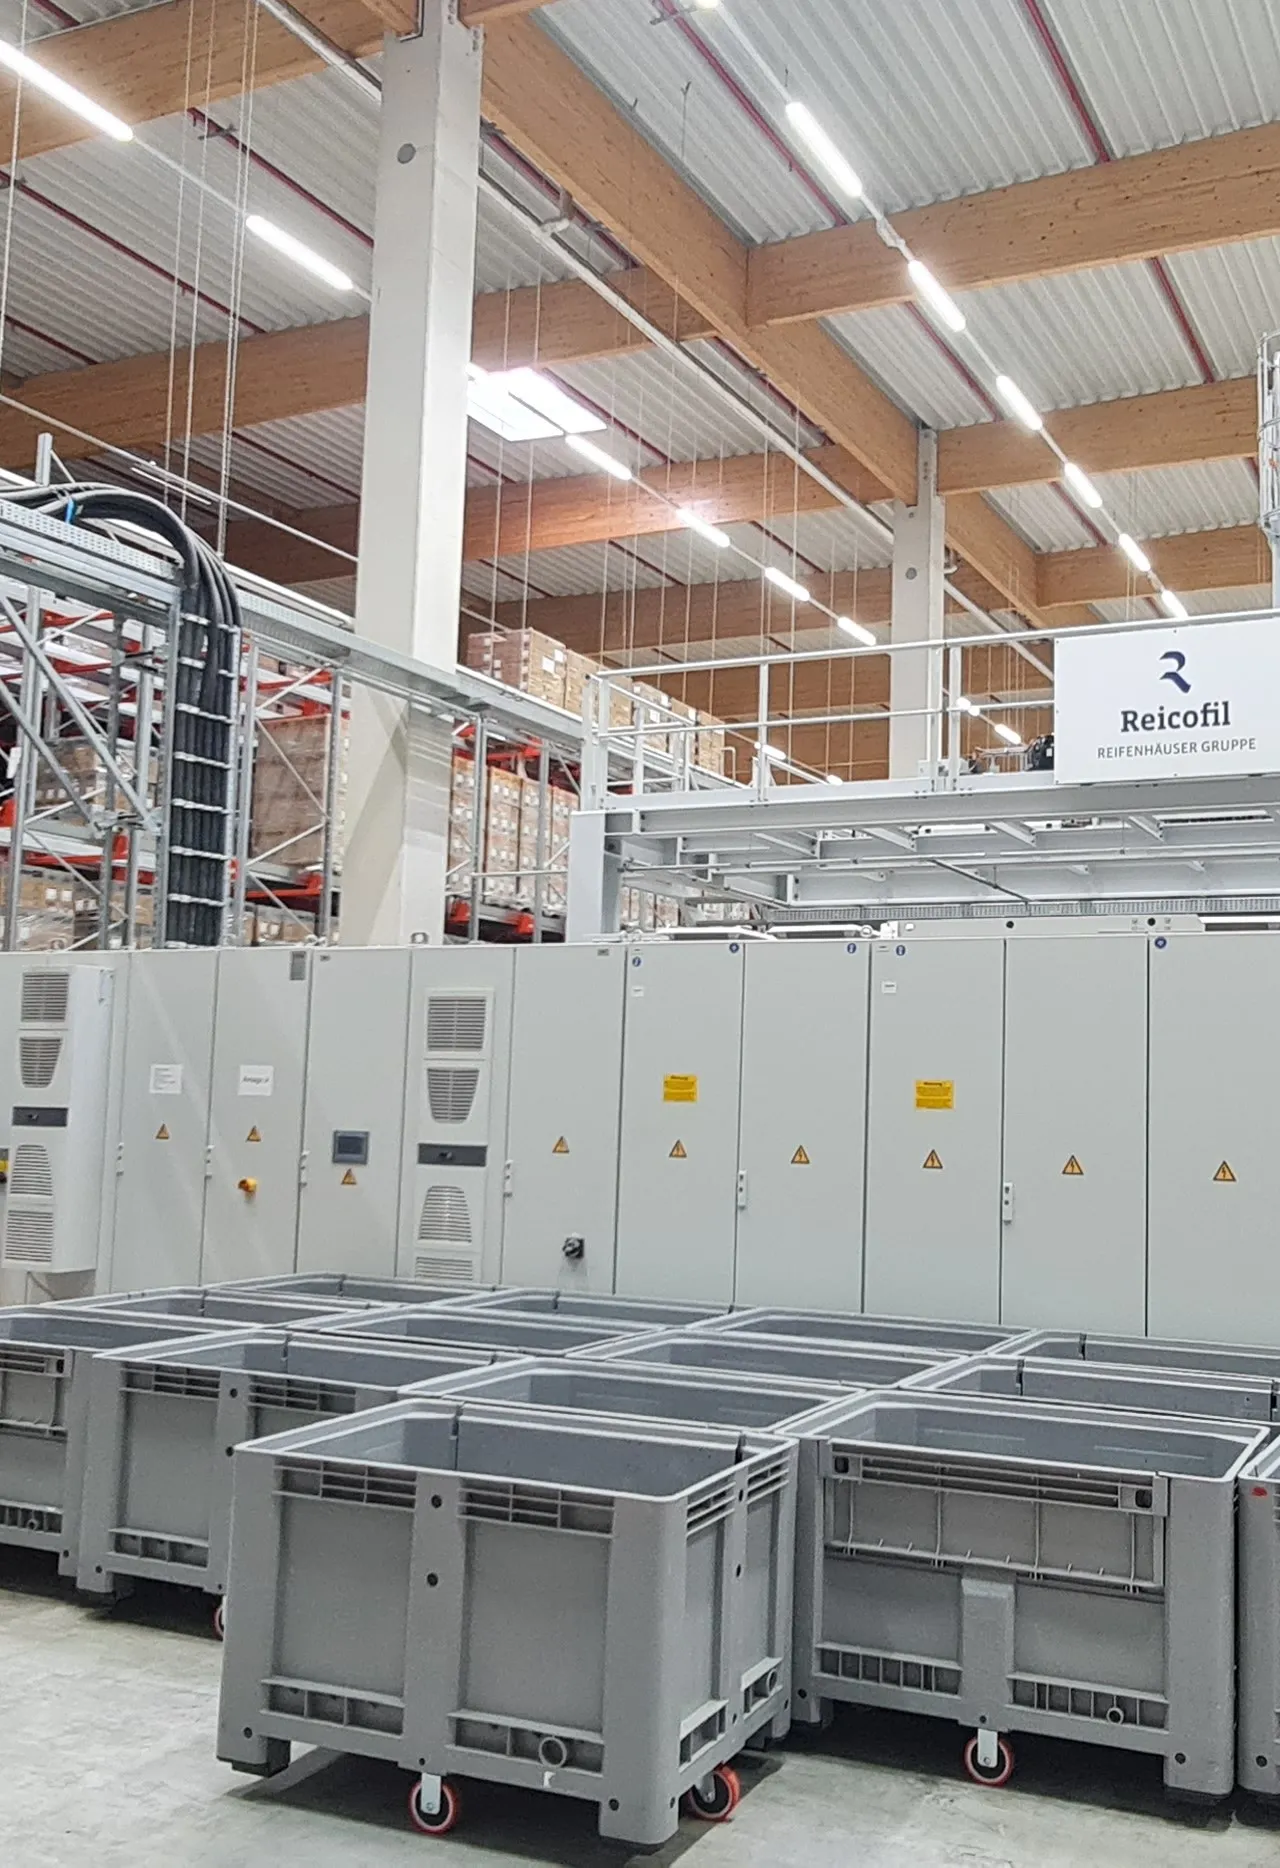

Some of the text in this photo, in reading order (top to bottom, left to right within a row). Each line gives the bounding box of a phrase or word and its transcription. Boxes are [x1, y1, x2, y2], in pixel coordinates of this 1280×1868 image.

[1120, 701, 1231, 733] Reicofil
[1097, 738, 1257, 759] REIFENHÄUSER GRUPPE
